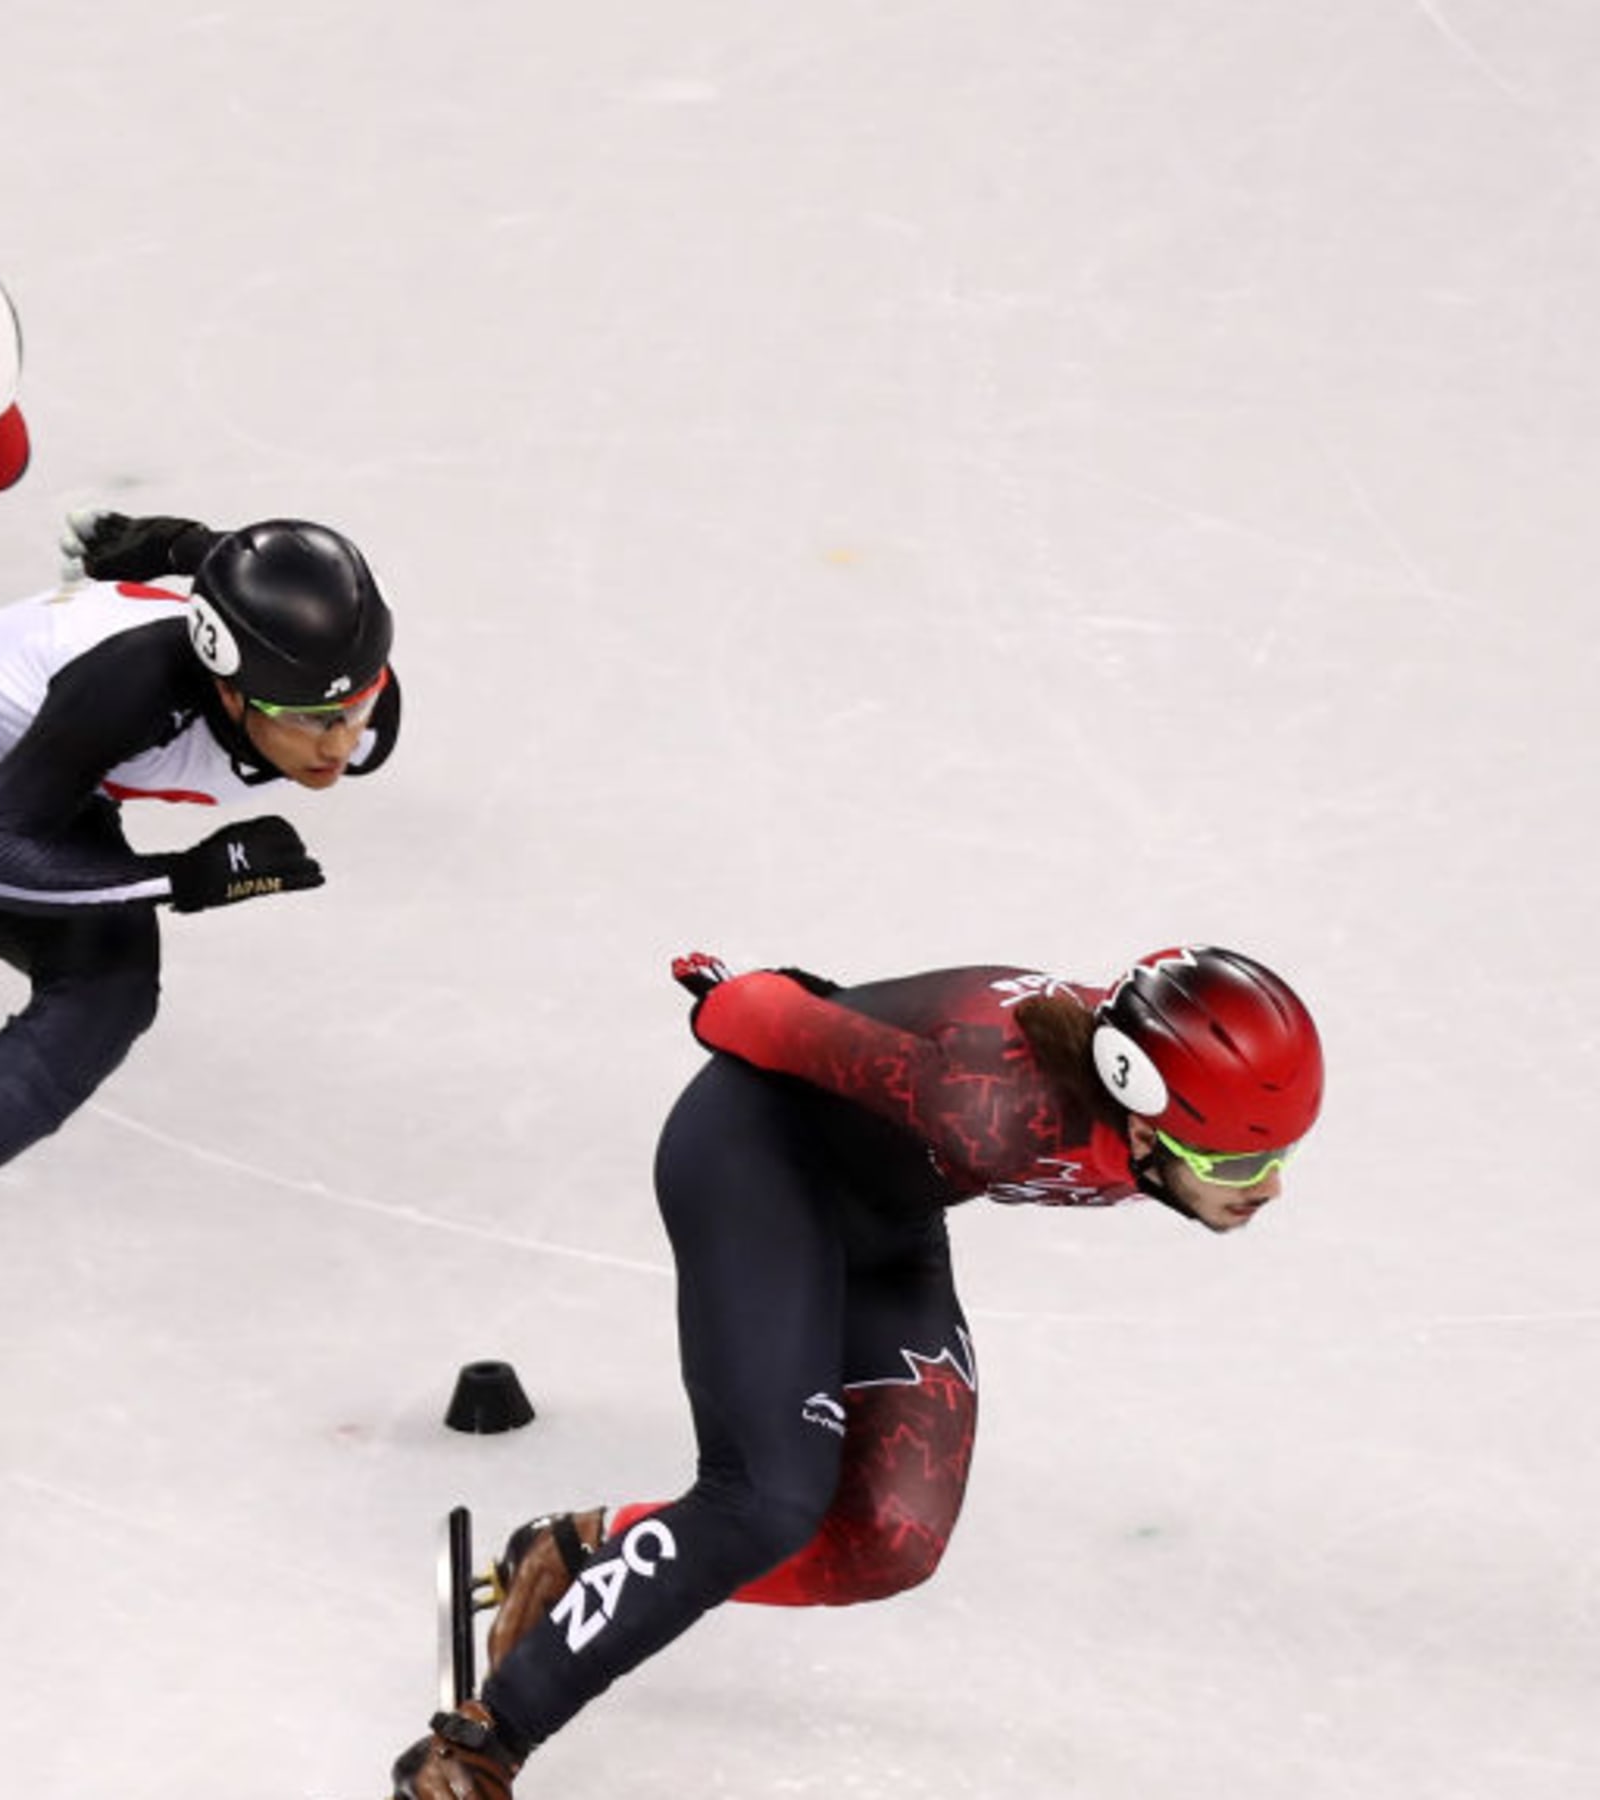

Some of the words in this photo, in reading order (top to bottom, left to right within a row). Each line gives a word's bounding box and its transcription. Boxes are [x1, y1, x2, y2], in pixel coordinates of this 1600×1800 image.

[225, 877, 282, 899] JAPAN
[1114, 1054, 1130, 1089] 3
[549, 1519, 678, 1654] CAN
